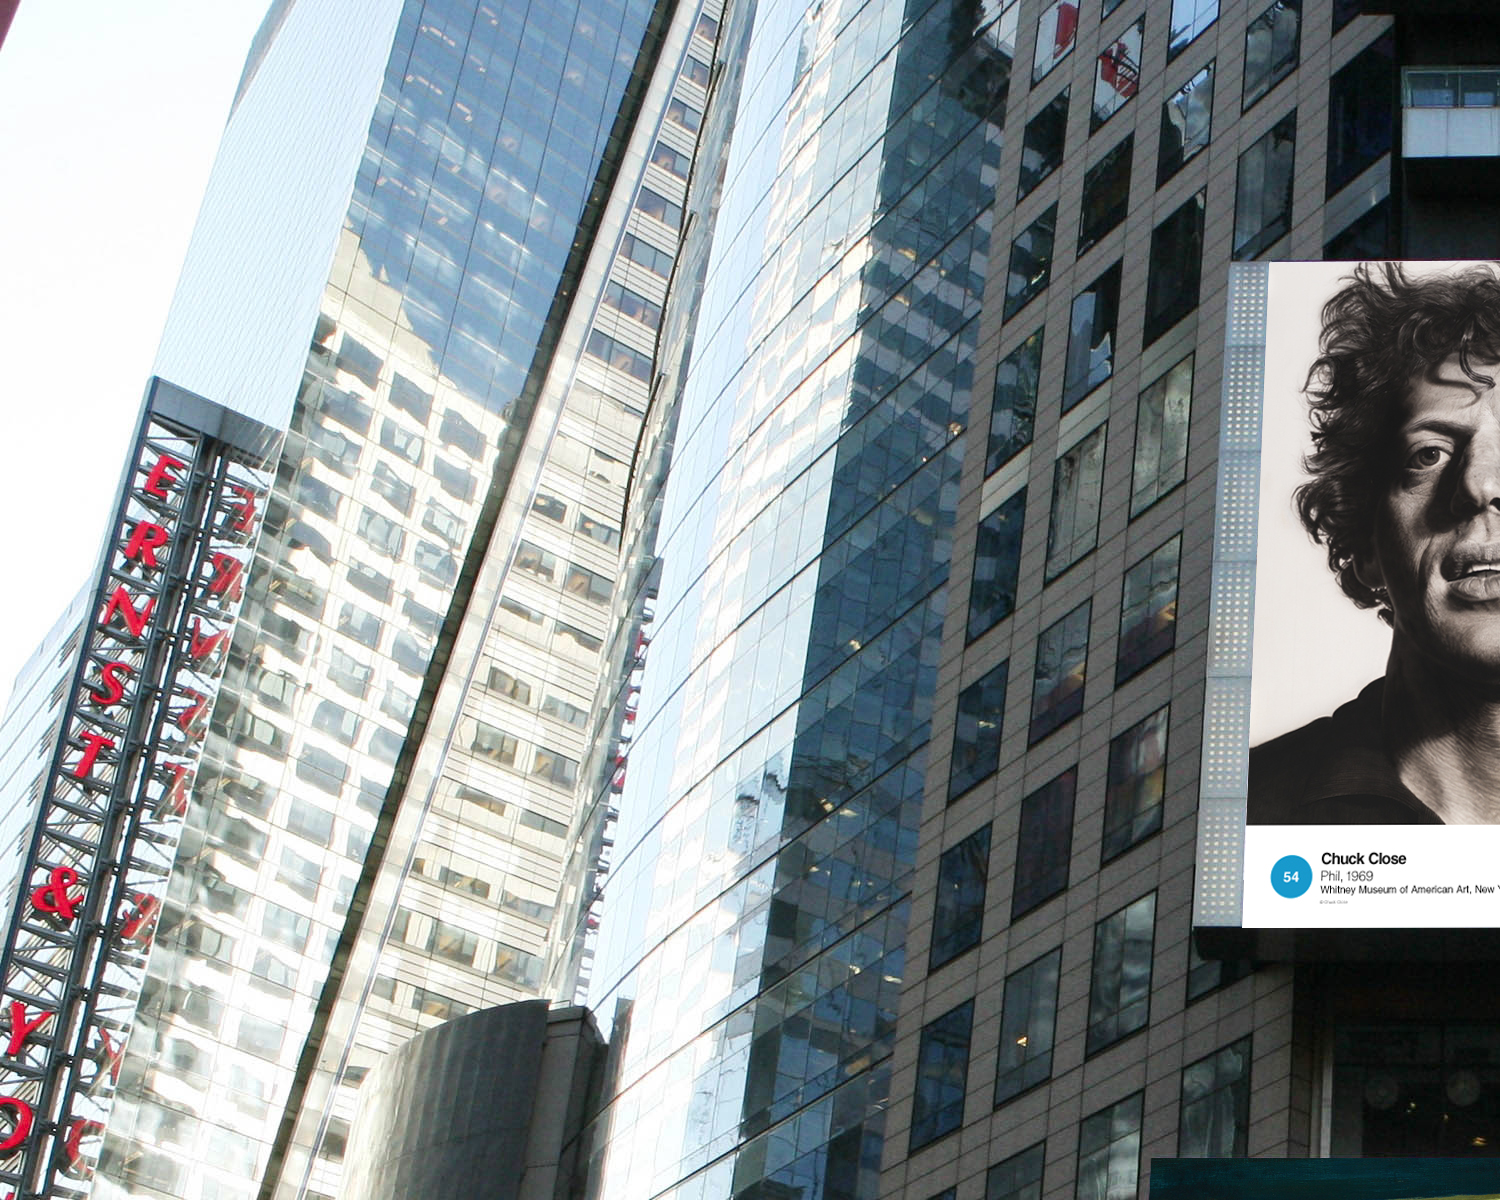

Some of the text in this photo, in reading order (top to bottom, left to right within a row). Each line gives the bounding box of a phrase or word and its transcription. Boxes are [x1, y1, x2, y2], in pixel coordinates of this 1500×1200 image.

[73, 455, 184, 779] ERNST
[1322, 852, 1407, 865] Chuck Close
[1283, 871, 1299, 883] 54
[1321, 870, 1374, 883] Phil, 1969
[31, 867, 84, 919] &
[1320, 885, 1356, 896] Whitney
[1359, 885, 1397, 894] Museum
[1400, 885, 1409, 894] of
[1411, 885, 1454, 894] American
[1456, 885, 1472, 895] Art,
[1475, 885, 1495, 894] New
